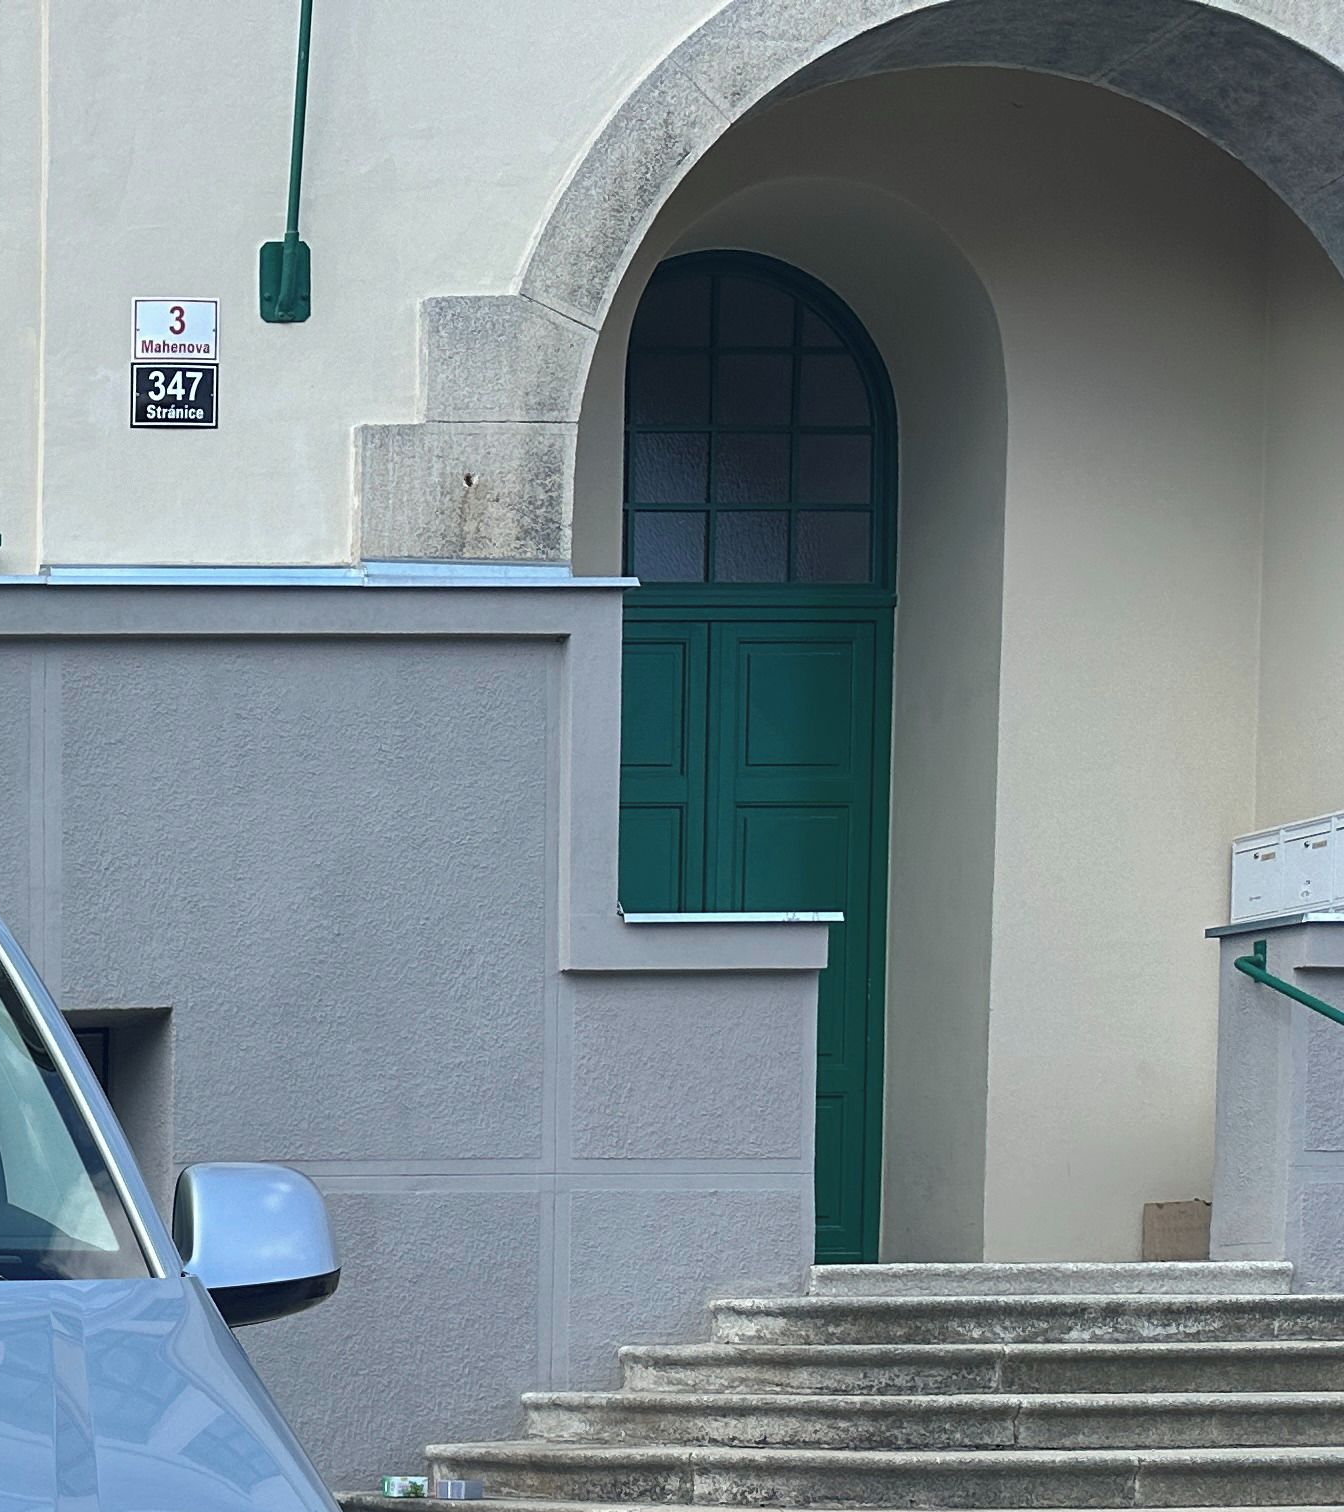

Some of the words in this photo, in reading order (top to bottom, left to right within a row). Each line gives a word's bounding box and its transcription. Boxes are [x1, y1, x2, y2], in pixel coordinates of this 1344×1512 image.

[169, 306, 186, 335] 3
[141, 340, 210, 354] Mahenova
[148, 370, 203, 401] 347
[146, 404, 204, 419] Stránice
